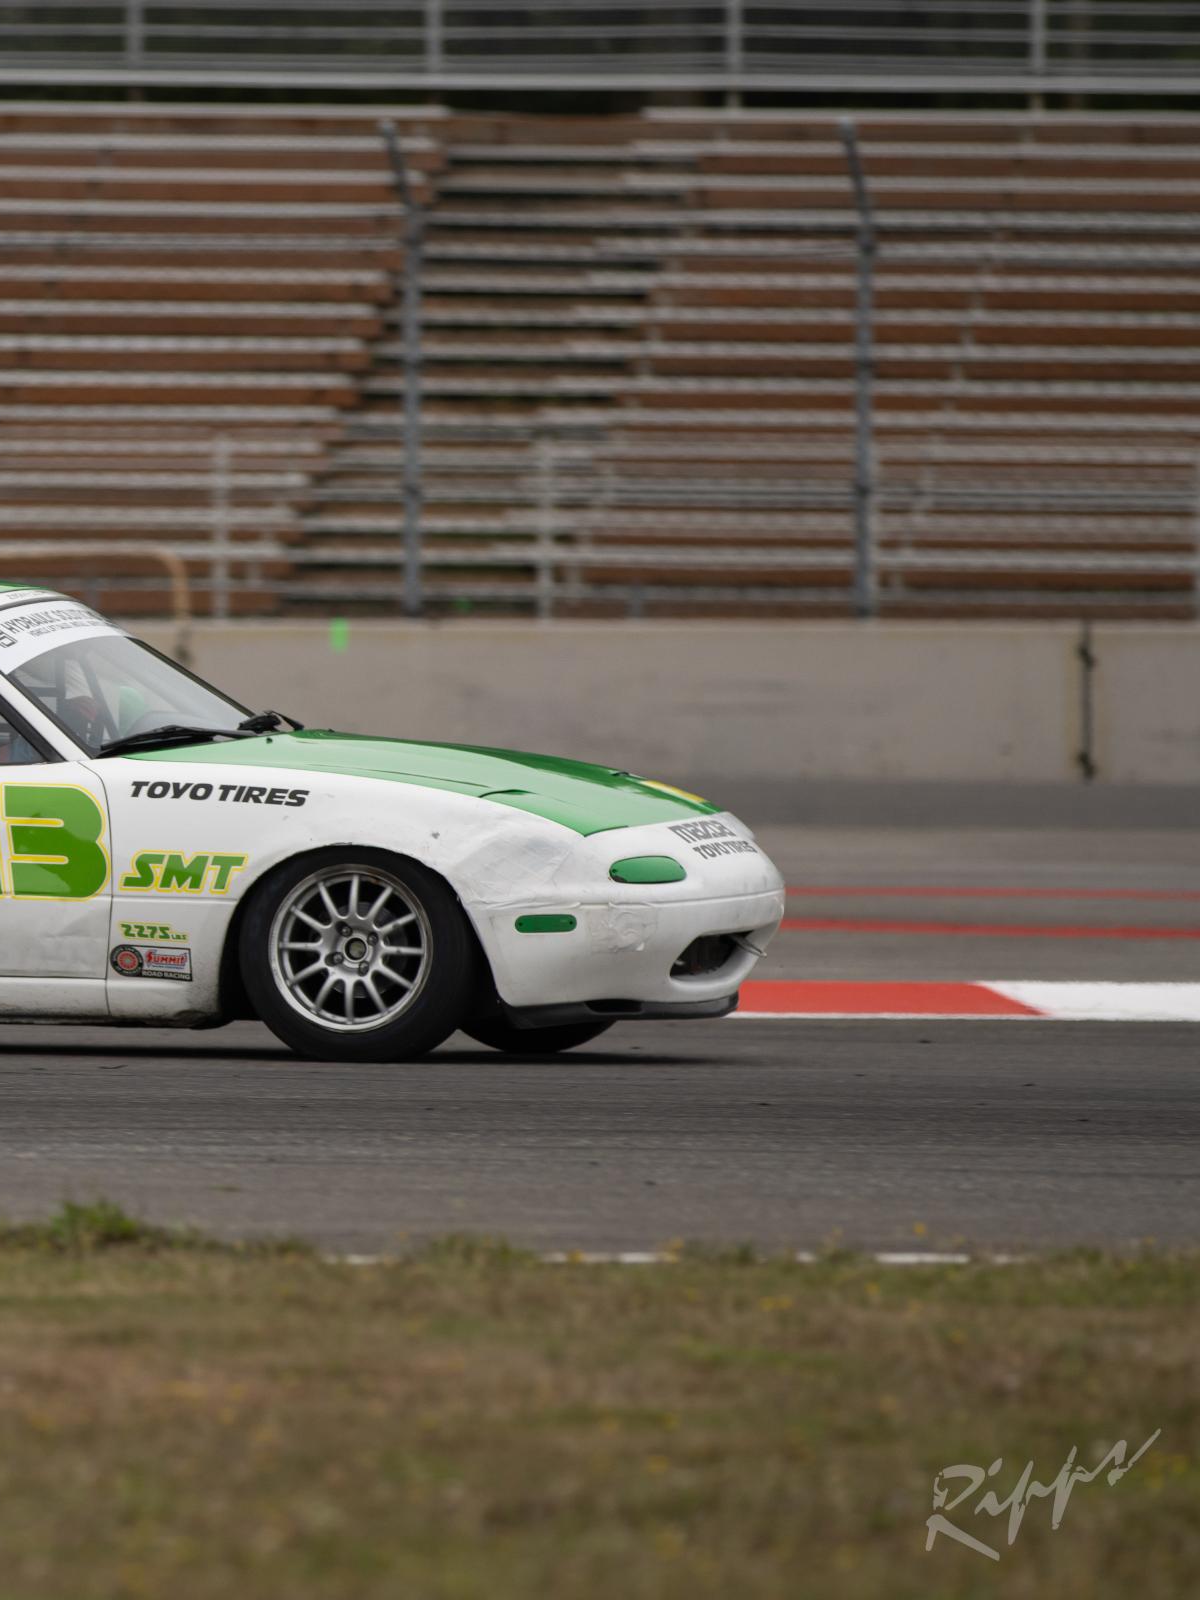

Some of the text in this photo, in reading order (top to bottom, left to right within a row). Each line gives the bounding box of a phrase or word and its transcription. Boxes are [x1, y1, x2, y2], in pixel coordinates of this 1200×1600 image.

[130, 780, 310, 808] TOYO TIRES
[692, 841, 731, 860] TOYO
[119, 850, 248, 894] SMT
[119, 922, 170, 940] 2275
[142, 970, 191, 980] ROAD RACING
